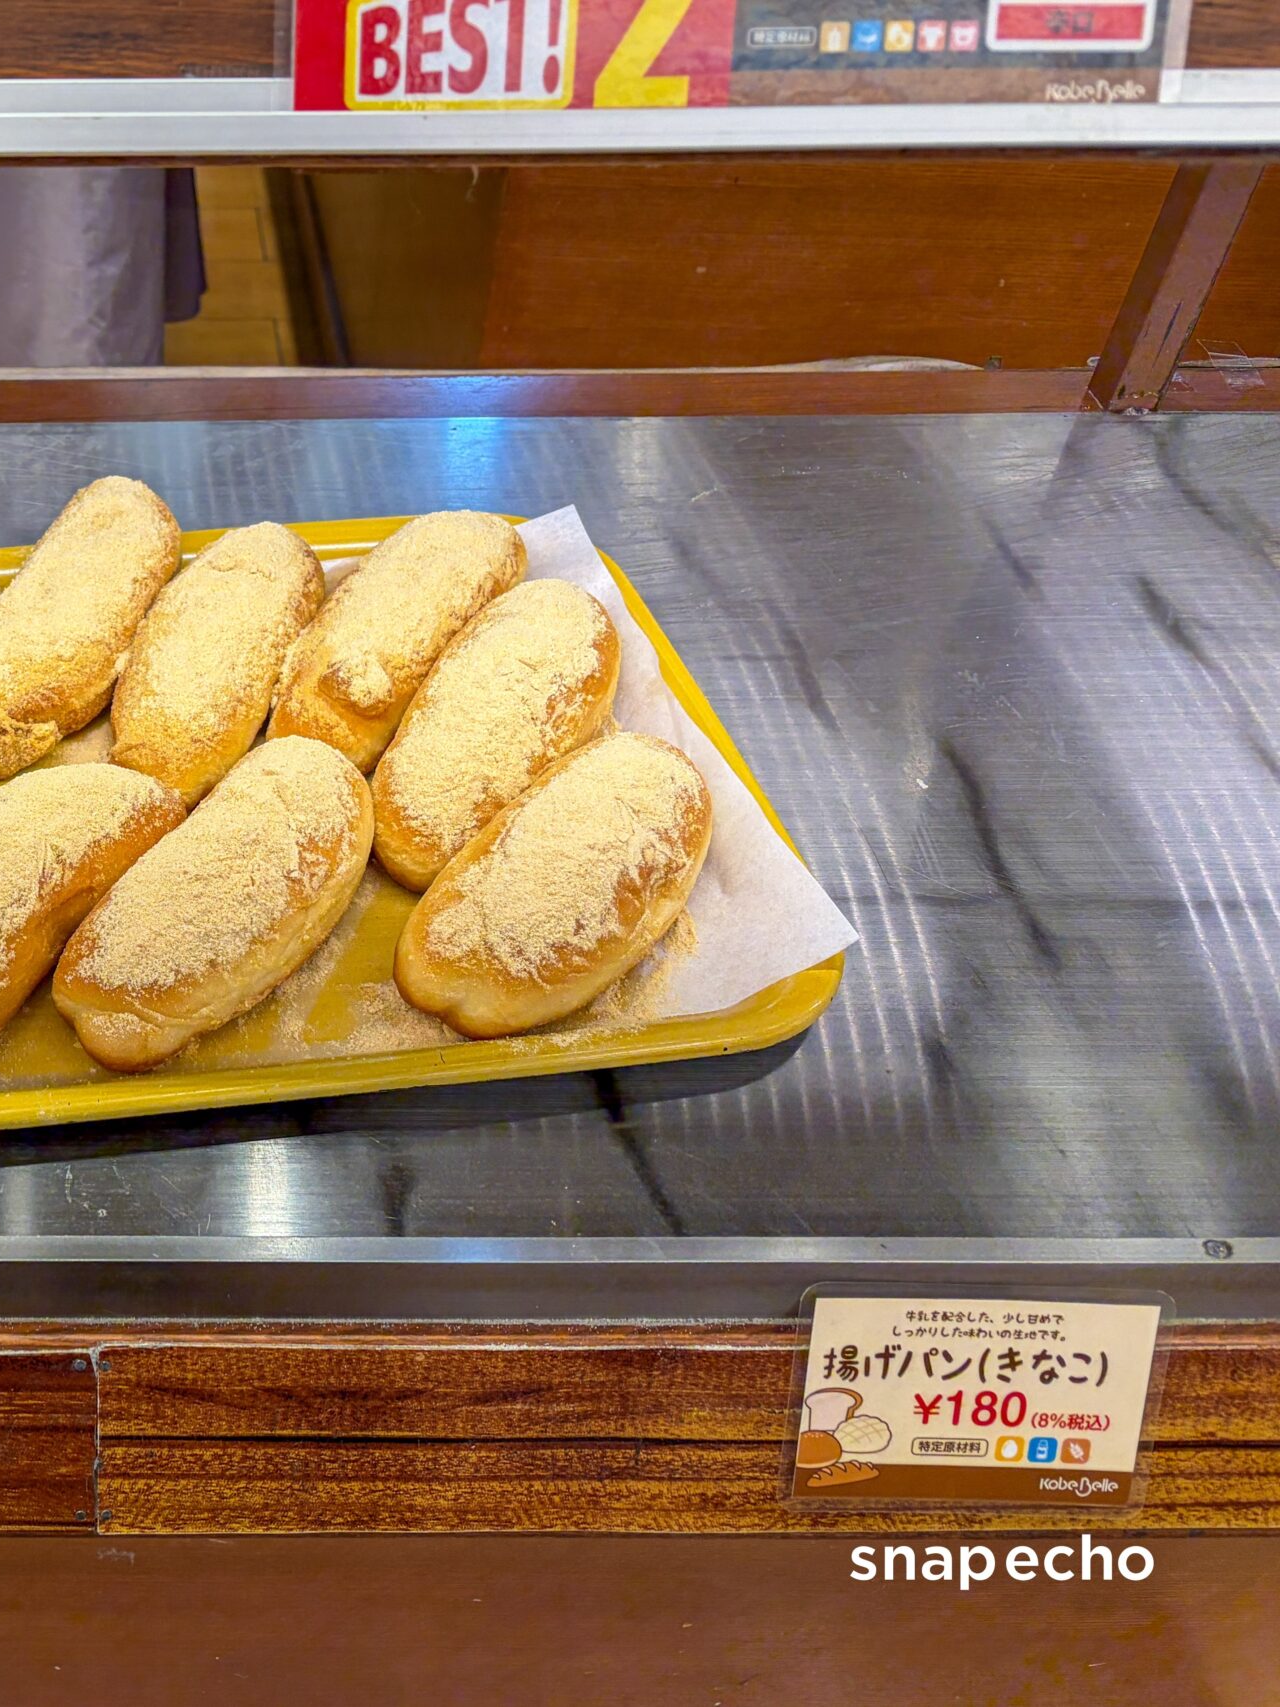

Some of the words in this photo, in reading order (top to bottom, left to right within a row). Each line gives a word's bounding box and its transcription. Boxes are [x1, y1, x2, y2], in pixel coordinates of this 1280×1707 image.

[358, 0, 562, 96] BEST!
[892, 1326, 1066, 1342] しっかりした味わいの生地です。
[913, 1390, 1027, 1427] ¥180
[1031, 1413, 1110, 1431] (8%税込)
[918, 1441, 981, 1455] 特定原材料
